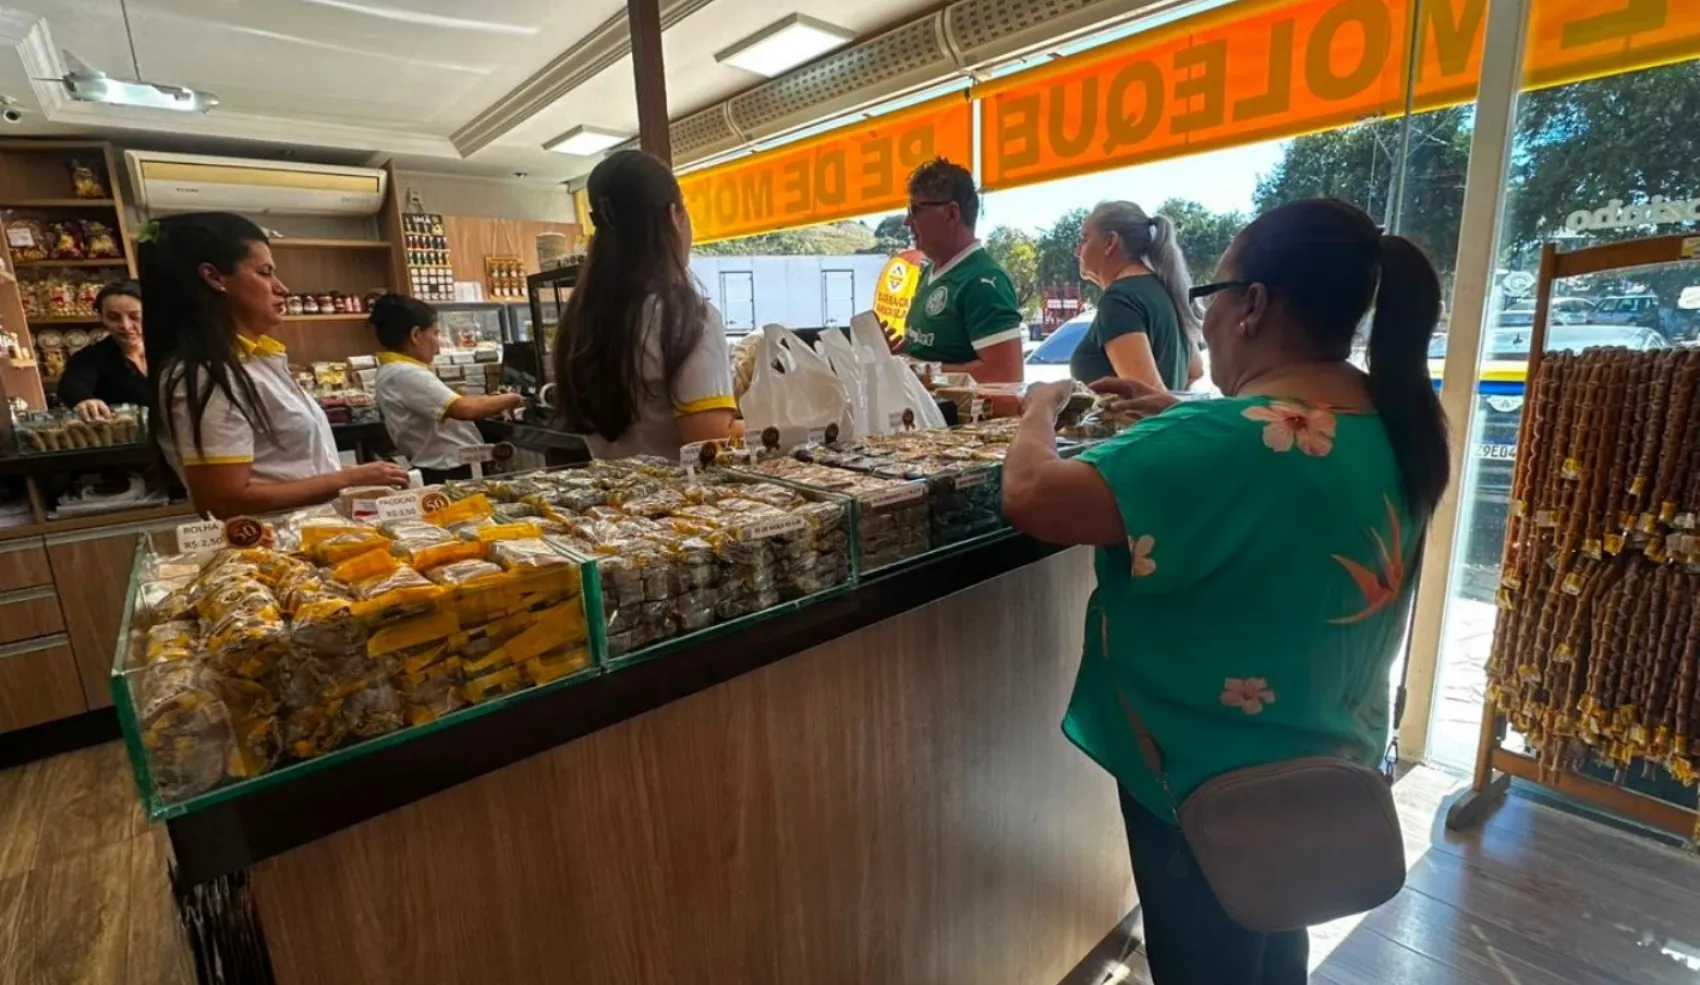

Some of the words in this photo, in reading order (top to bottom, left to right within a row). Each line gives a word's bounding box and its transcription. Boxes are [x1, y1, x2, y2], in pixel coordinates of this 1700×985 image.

[183, 522, 218, 534] ROLHA
[233, 523, 258, 542] 50
[184, 540, 197, 550] R$
